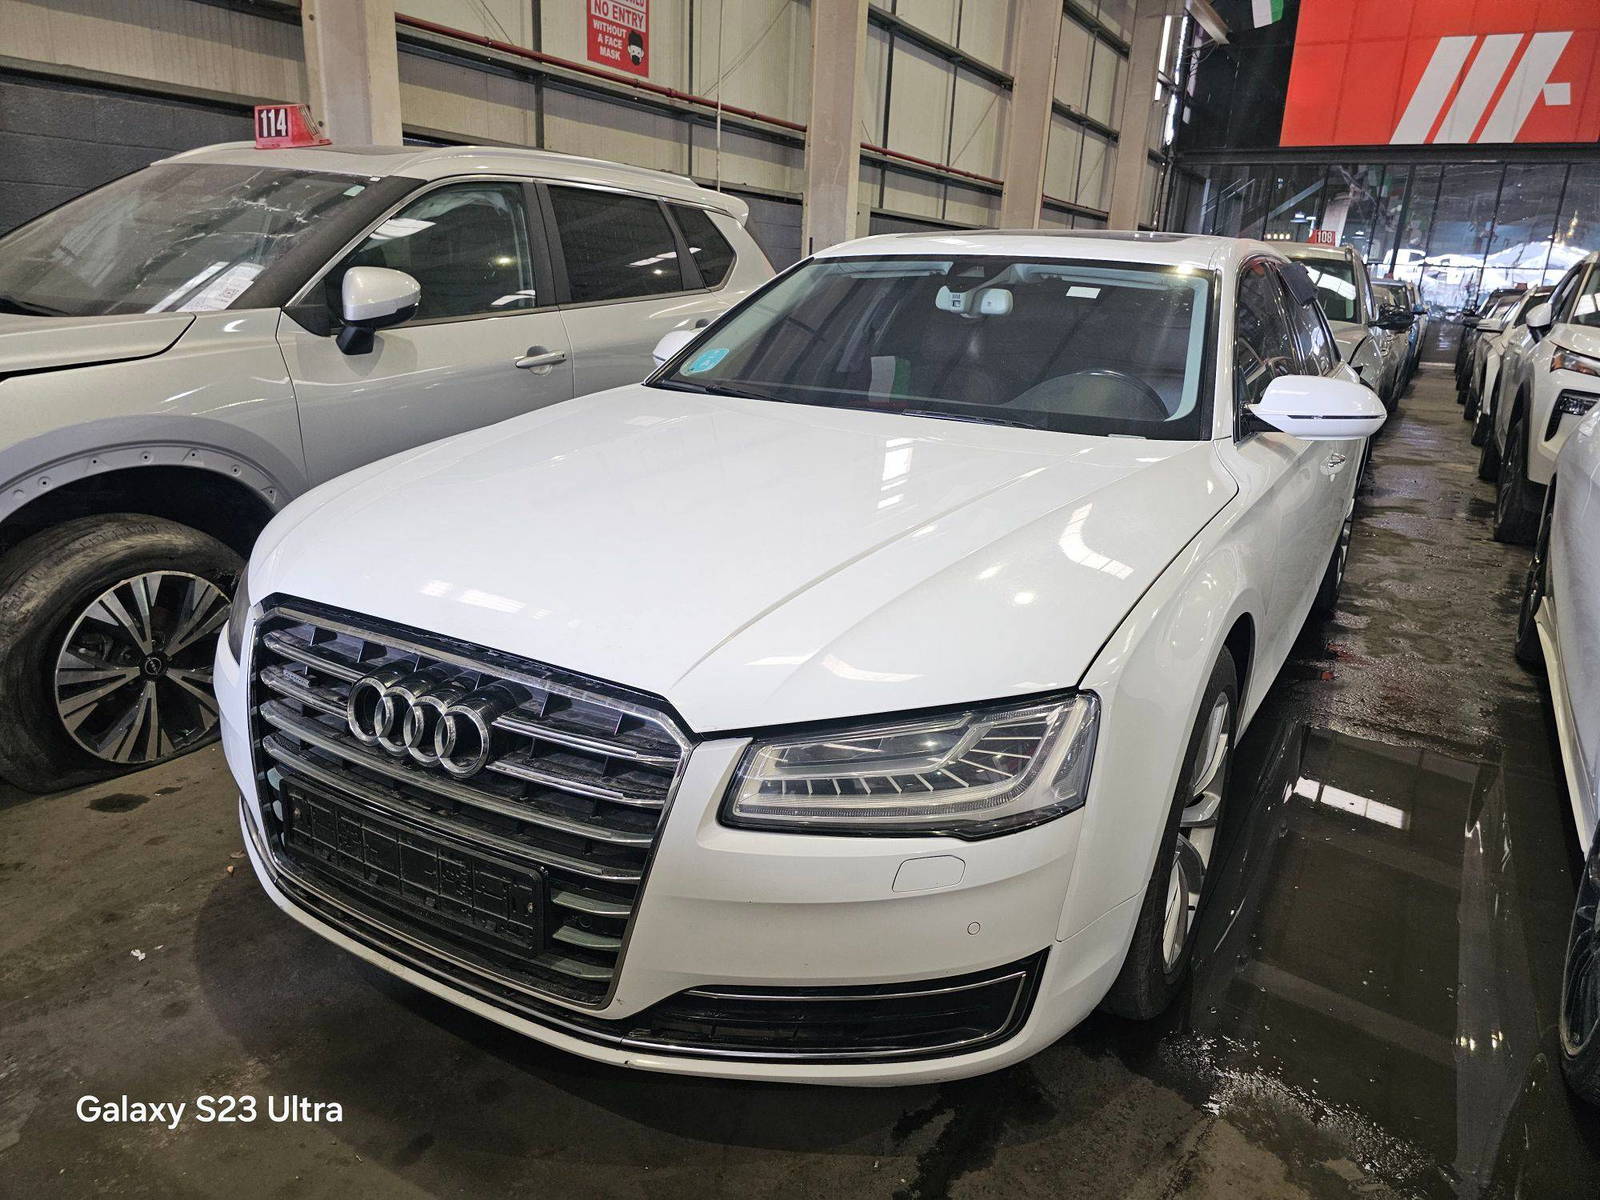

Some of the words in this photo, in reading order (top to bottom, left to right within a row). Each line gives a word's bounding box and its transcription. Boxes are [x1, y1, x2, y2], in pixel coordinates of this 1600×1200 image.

[594, 0, 609, 16] NO
[612, 4, 644, 29] ENTRY
[593, 19, 627, 38] WITHOUT
[597, 33, 603, 43] A
[604, 35, 623, 49] FACE
[599, 46, 621, 60] MASK
[260, 108, 287, 137] 114
